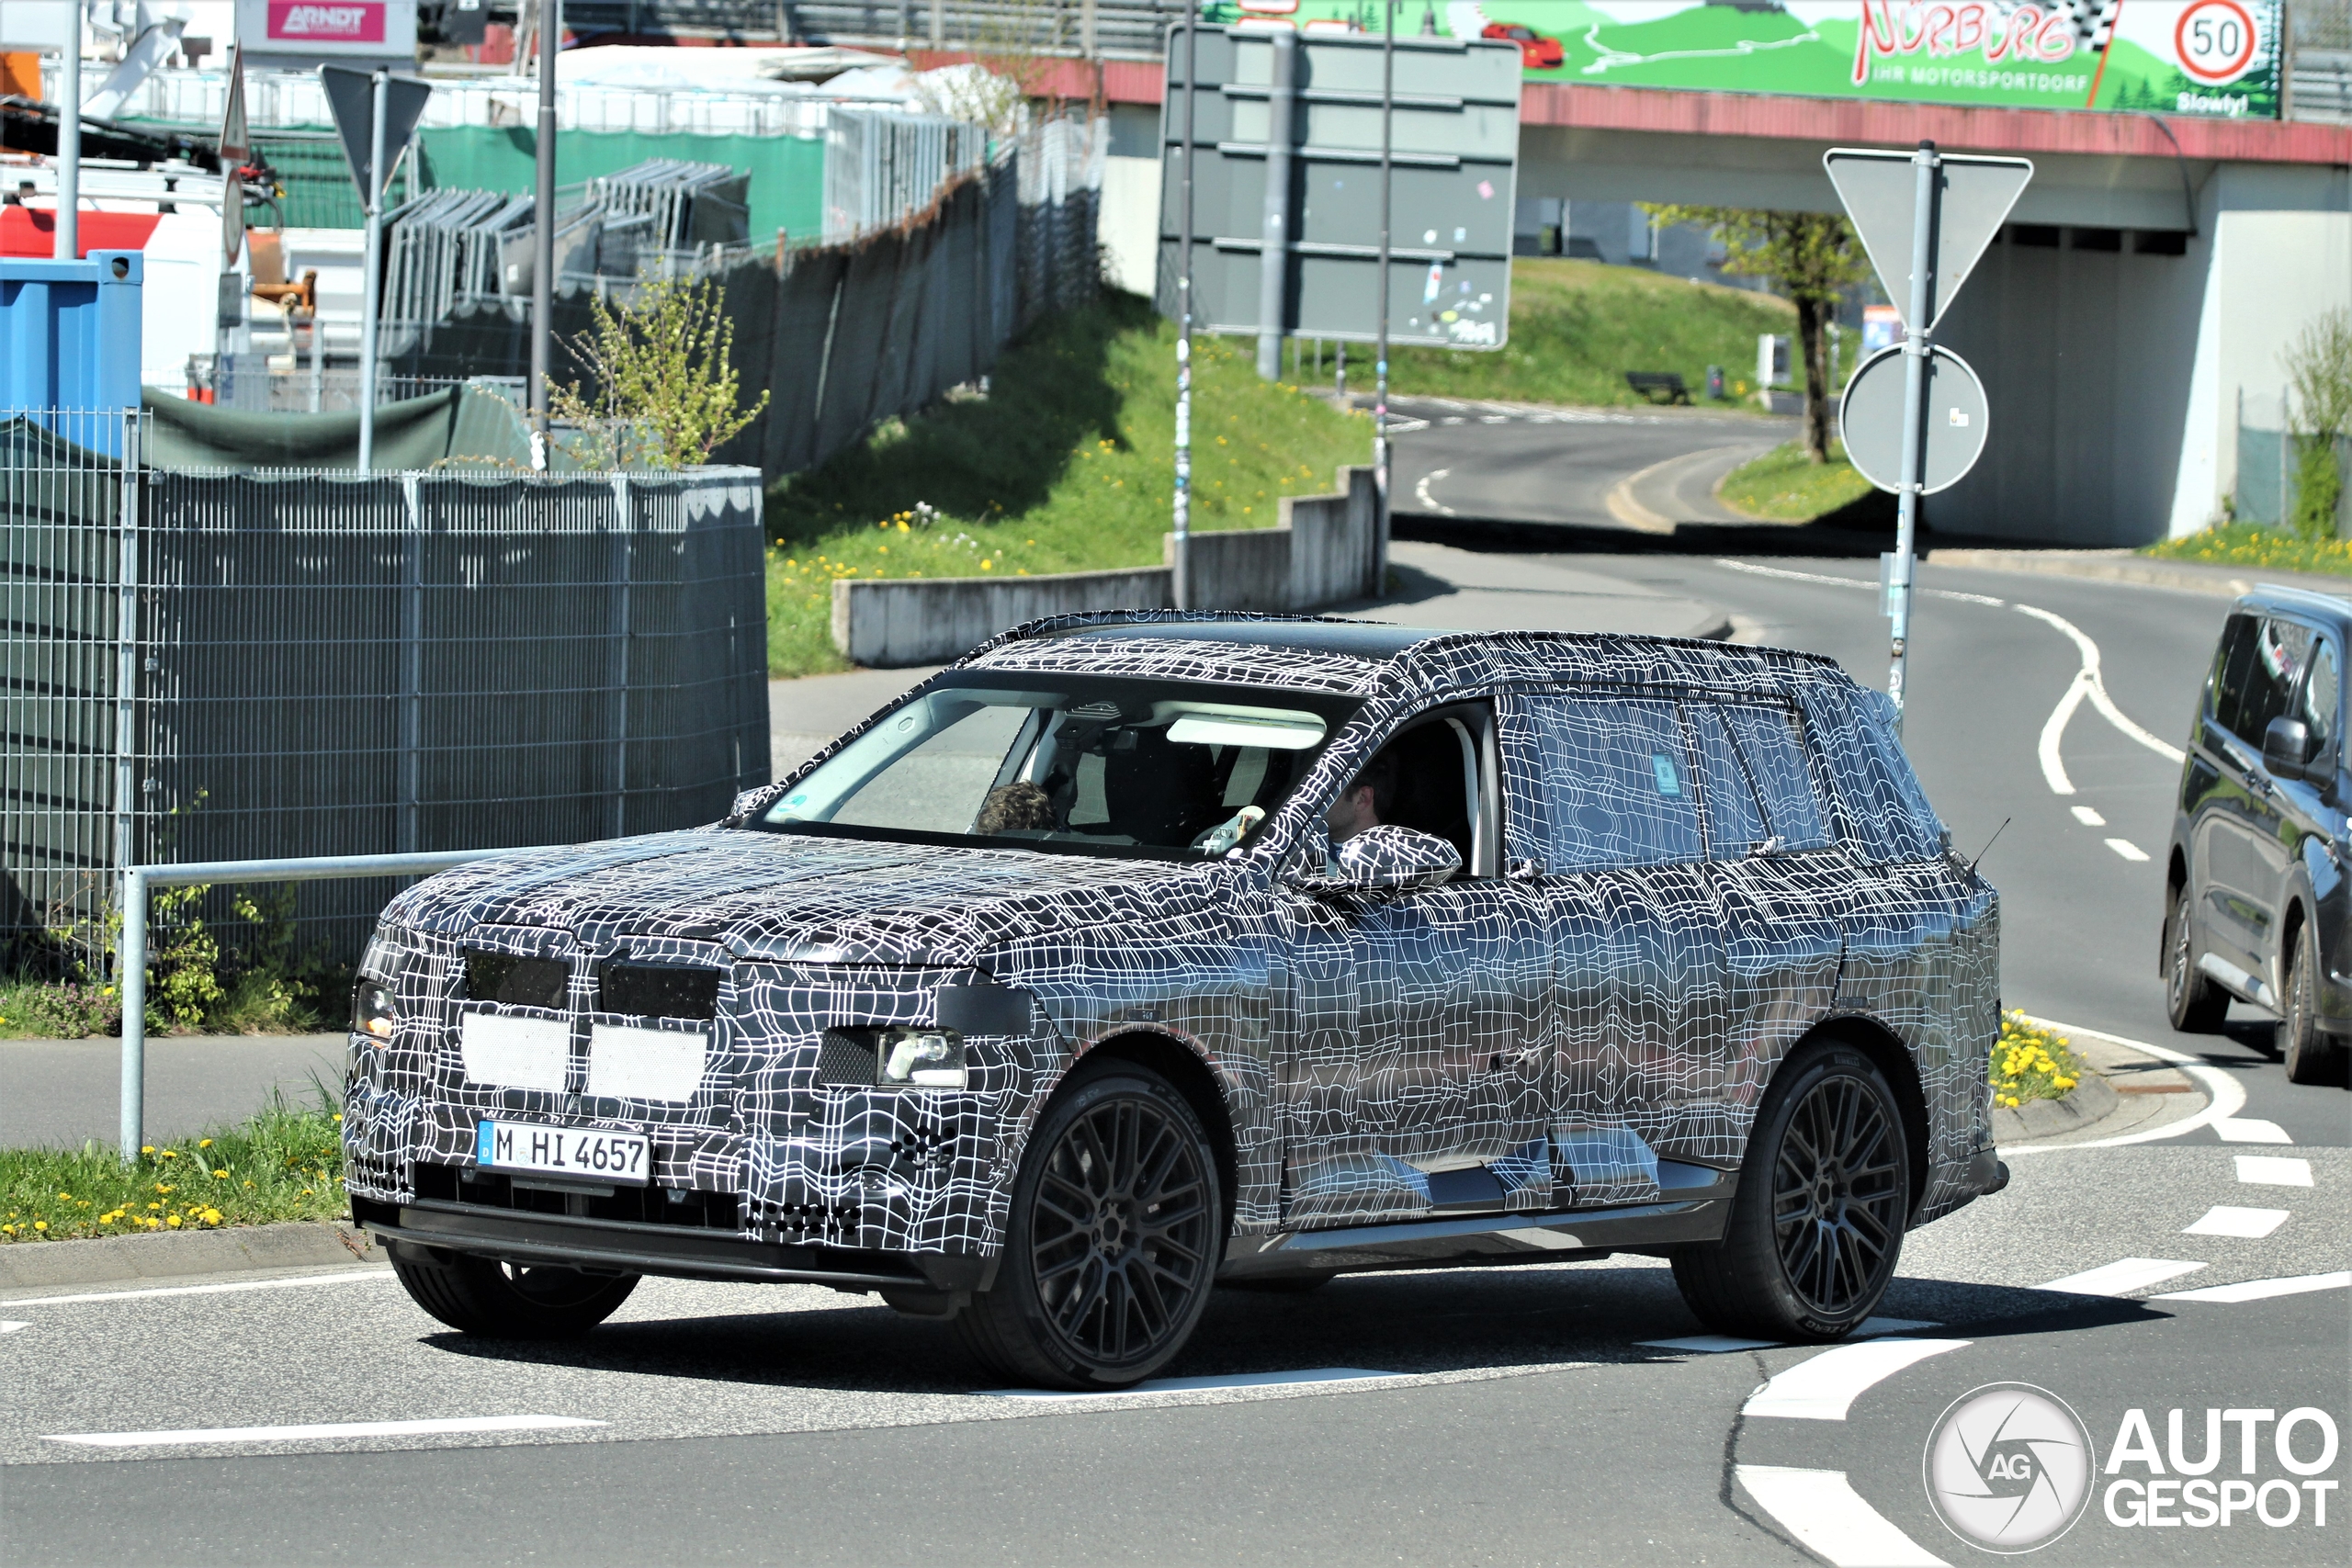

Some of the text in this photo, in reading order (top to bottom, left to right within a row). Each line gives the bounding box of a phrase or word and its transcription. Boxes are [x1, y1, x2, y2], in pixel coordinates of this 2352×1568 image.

[282, 5, 366, 33] ARNDT
[2194, 19, 2238, 56] 50
[1872, 65, 2088, 92] IHR MOTORSPORTDORF
[2177, 91, 2249, 118] Slowly!
[1170, 1094, 1202, 1135] ZERO
[482, 1146, 490, 1157] D
[496, 1128, 644, 1173] M HI 4657
[1805, 1320, 1840, 1334] ZERO
